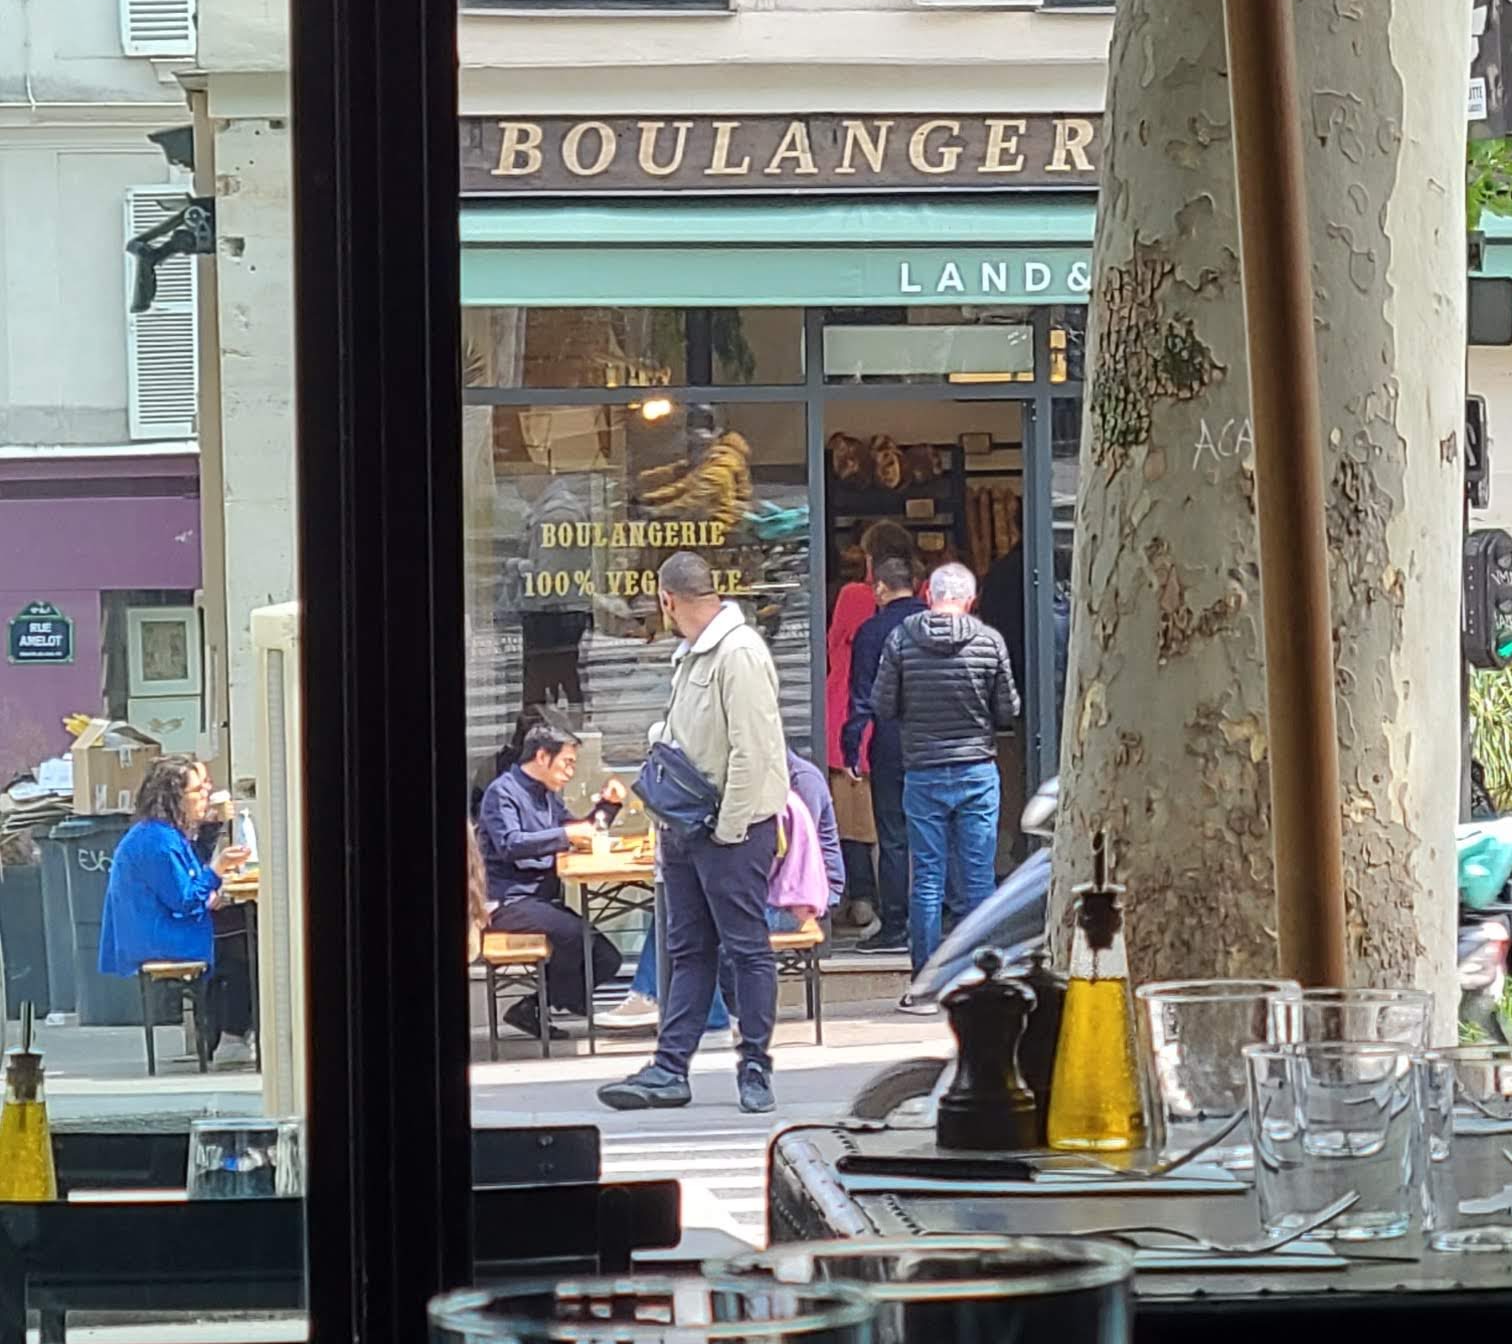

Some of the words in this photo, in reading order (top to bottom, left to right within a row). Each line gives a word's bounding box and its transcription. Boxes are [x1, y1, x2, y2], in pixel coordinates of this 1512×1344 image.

[541, 520, 726, 548] BOULANGERIE
[524, 569, 596, 597] 100%
[606, 568, 744, 596] VEGLE
[29, 622, 52, 633] RUE
[18, 635, 63, 647] AMELOT
